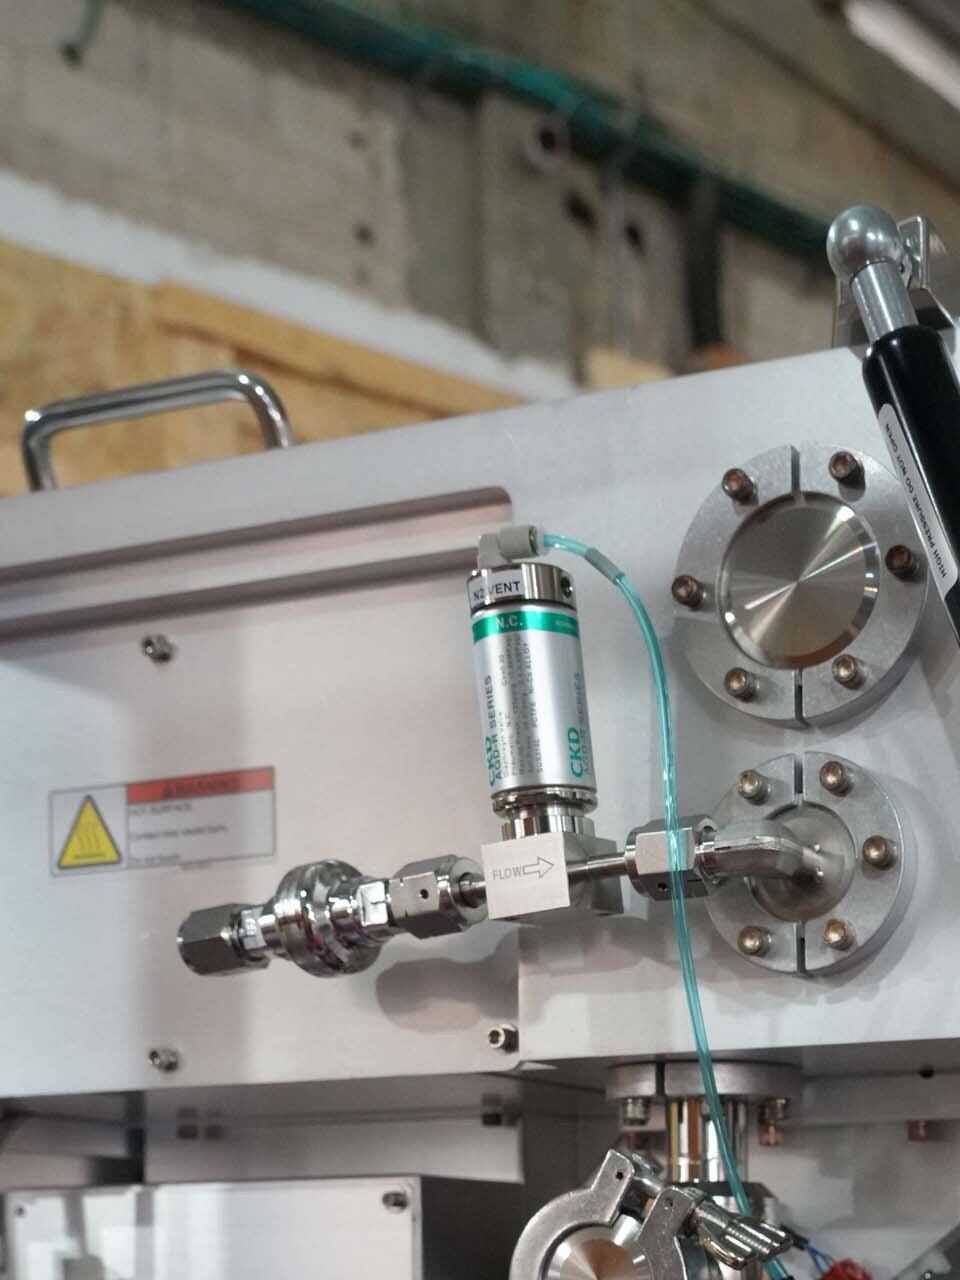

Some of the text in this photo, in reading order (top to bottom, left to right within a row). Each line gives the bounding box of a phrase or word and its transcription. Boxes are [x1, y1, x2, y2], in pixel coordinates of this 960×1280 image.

[885, 423, 947, 578] HIGH PRESSURE DO NOT OPEN
[488, 581, 521, 596] VENT
[485, 675, 497, 729] SERIES
[567, 727, 584, 778] CKD
[492, 865, 521, 880] FLOW
